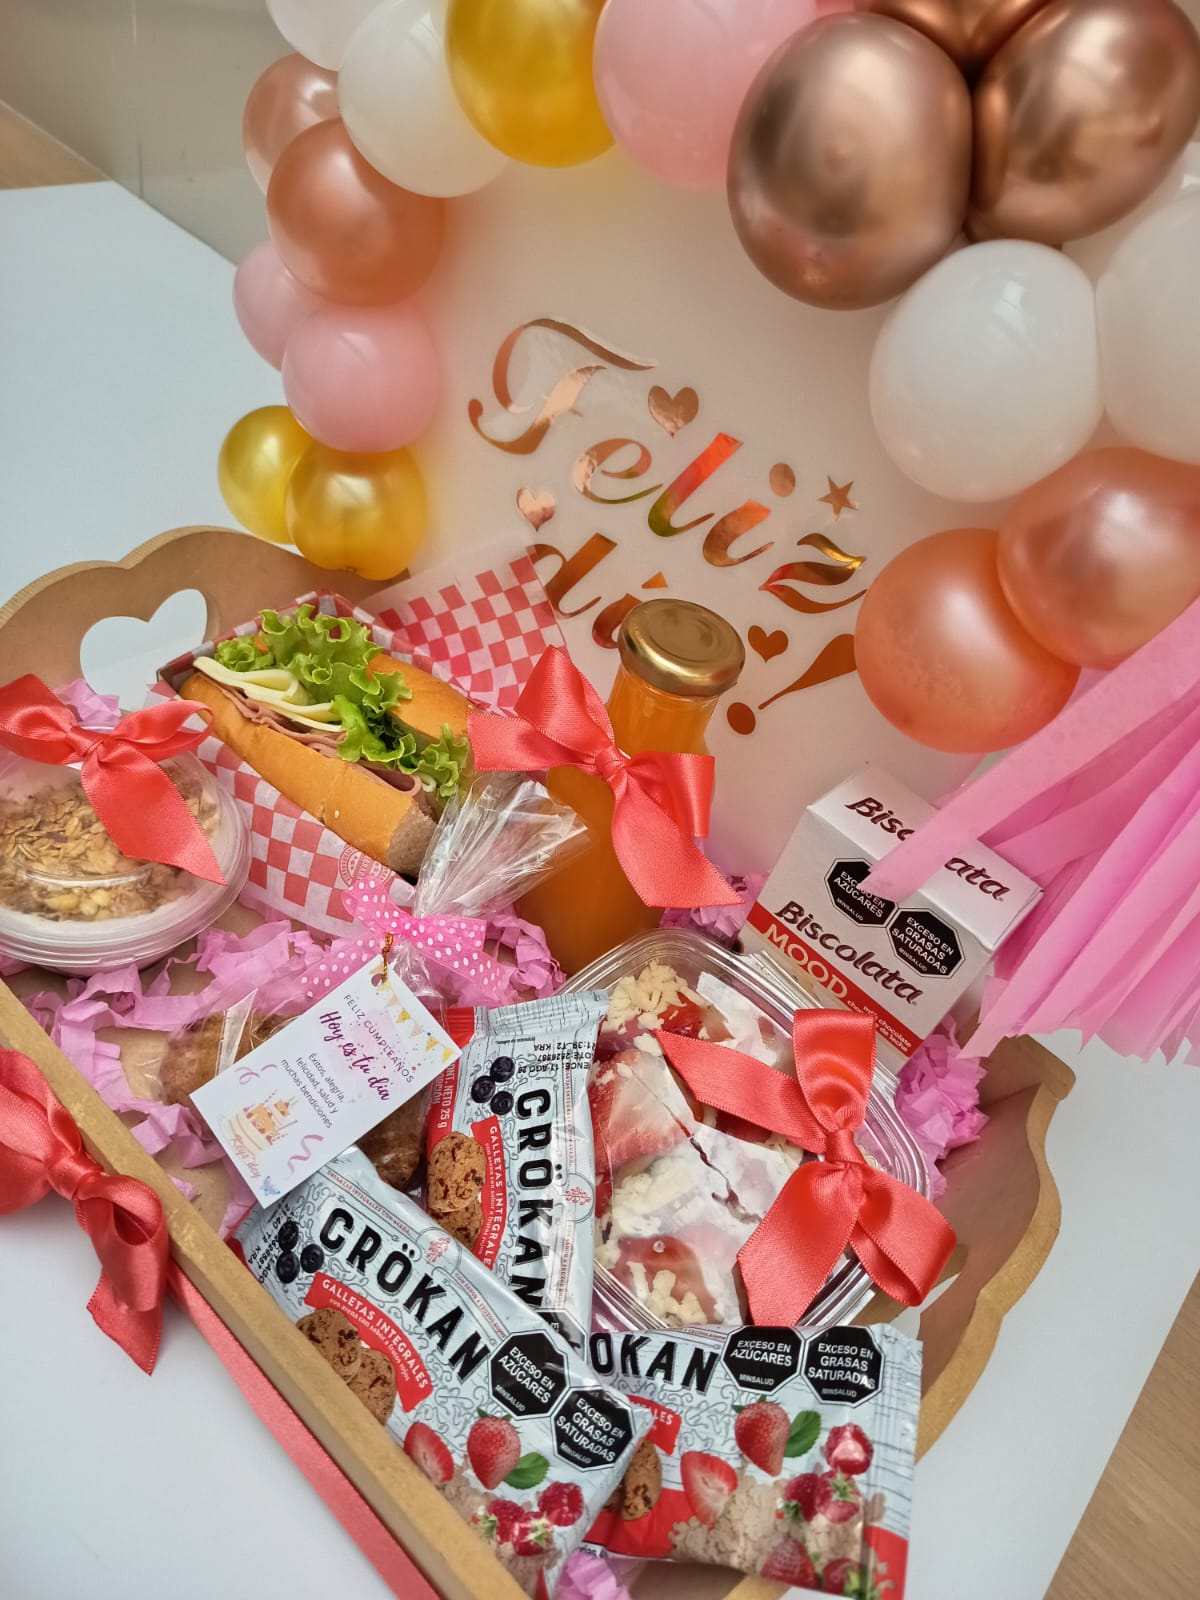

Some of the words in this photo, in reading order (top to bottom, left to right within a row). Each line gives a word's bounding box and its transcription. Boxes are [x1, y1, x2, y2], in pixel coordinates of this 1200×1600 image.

[468, 318, 867, 614] Feliz
[845, 797, 1010, 901] Biscata
[872, 896, 885, 908] EN
[775, 900, 923, 1005] Biscolata
[890, 927, 948, 974] SATURADAS
[904, 925, 946, 960] GRASAS
[905, 916, 941, 945] EXCESO
[940, 942, 954, 955] EN
[762, 923, 848, 999] MOOD
[320, 1011, 344, 1042] Hoy
[342, 1042, 356, 1059] es
[352, 1053, 374, 1074] tu
[343, 994, 365, 1019] FELIZ
[362, 1019, 415, 1083] CUMPLEAÑOS
[534, 1043, 551, 1051] KRA
[294, 1056, 321, 1089] felicidad,
[316, 1086, 335, 1108] salud
[444, 1063, 455, 1084] ONT.
[562, 1062, 591, 1070] ENCE:
[279, 1058, 303, 1087] muchas
[299, 1084, 334, 1128] bendiciones
[441, 1085, 452, 1106] NETO
[439, 1108, 449, 1120] 25
[490, 1126, 503, 1187] GALLETAS
[483, 1192, 503, 1266] INTEGRALE
[248, 1245, 261, 1264] KRA
[319, 1207, 491, 1382] CRÖKAN
[323, 1279, 376, 1319] GALLETAS
[376, 1318, 428, 1388] INTEGRALES
[737, 1340, 775, 1351] EXCESO
[777, 1343, 791, 1353] EN
[818, 1343, 858, 1355] EXCESO
[860, 1348, 874, 1360] EN
[499, 1355, 551, 1403] AZÚCARES
[510, 1347, 542, 1380] EXCESO
[541, 1376, 555, 1391] EN
[739, 1373, 774, 1385] MINSALUD
[808, 1367, 875, 1390] SATURADAS
[820, 1356, 869, 1372] GRASAS
[495, 1385, 525, 1411] MINSALUD
[576, 1398, 611, 1432] EXCESO
[612, 1428, 625, 1439] EN
[557, 1416, 616, 1462] SATURADAS
[572, 1412, 615, 1446] GRASAS
